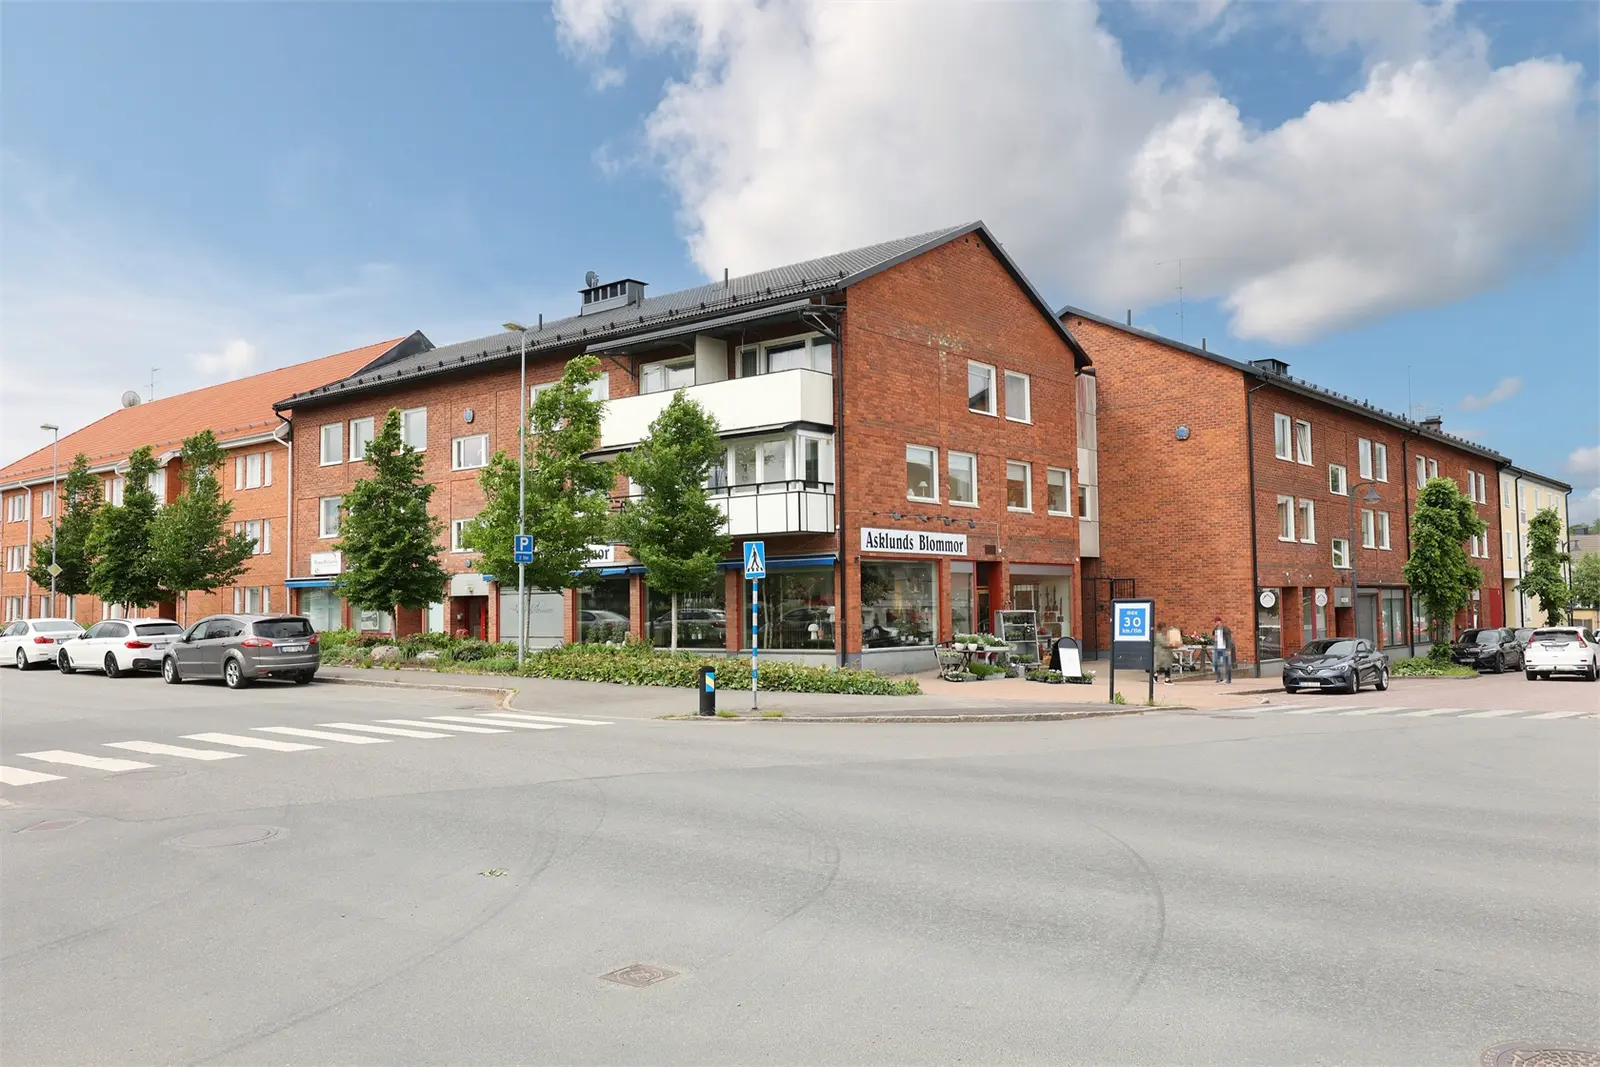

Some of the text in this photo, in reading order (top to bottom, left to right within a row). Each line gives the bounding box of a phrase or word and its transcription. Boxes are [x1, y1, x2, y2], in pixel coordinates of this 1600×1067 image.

[520, 537, 529, 551] P
[866, 531, 964, 553] Asklunds Blommor
[1123, 617, 1141, 627] 30
